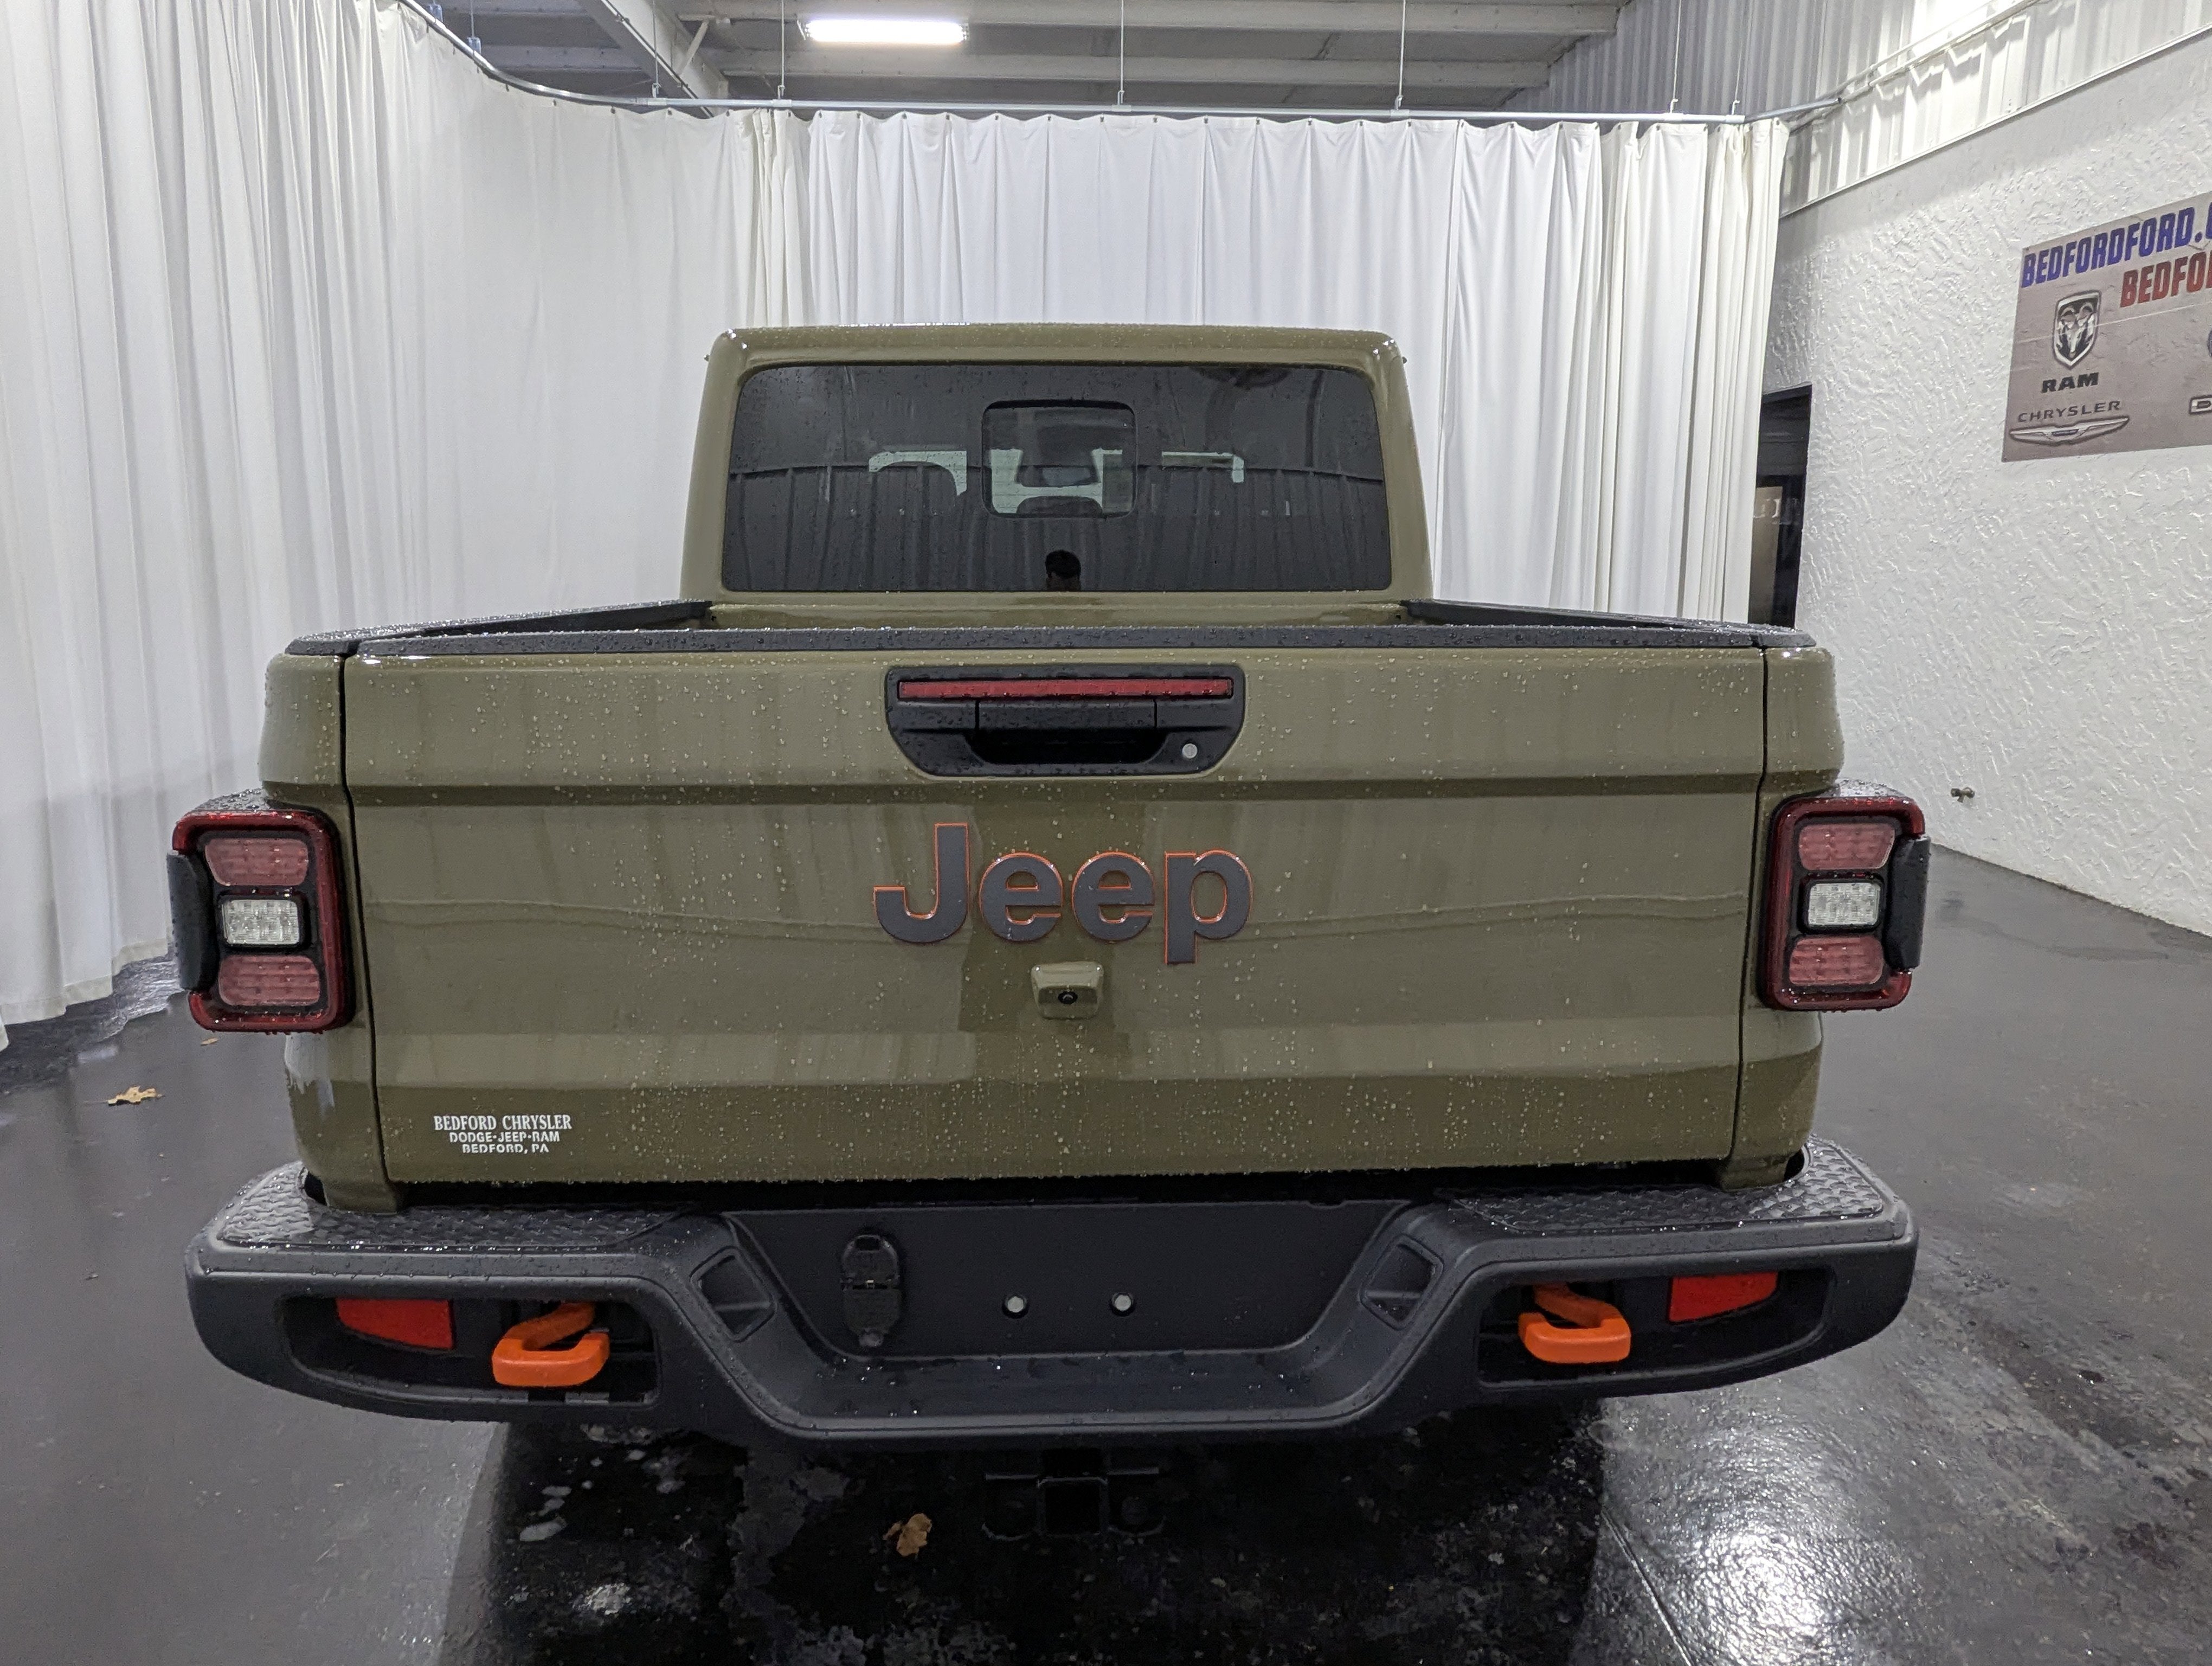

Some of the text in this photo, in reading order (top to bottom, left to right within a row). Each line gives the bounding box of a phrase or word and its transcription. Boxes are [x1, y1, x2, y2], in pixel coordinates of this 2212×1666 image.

[2041, 373, 2099, 393] RAM
[2018, 401, 2120, 422] CHRYSLER
[873, 822, 1253, 964] Jeep
[434, 1114, 572, 1131] BEDFORD CHRYSLER
[462, 1143, 549, 1154] BEDFORD, PA
